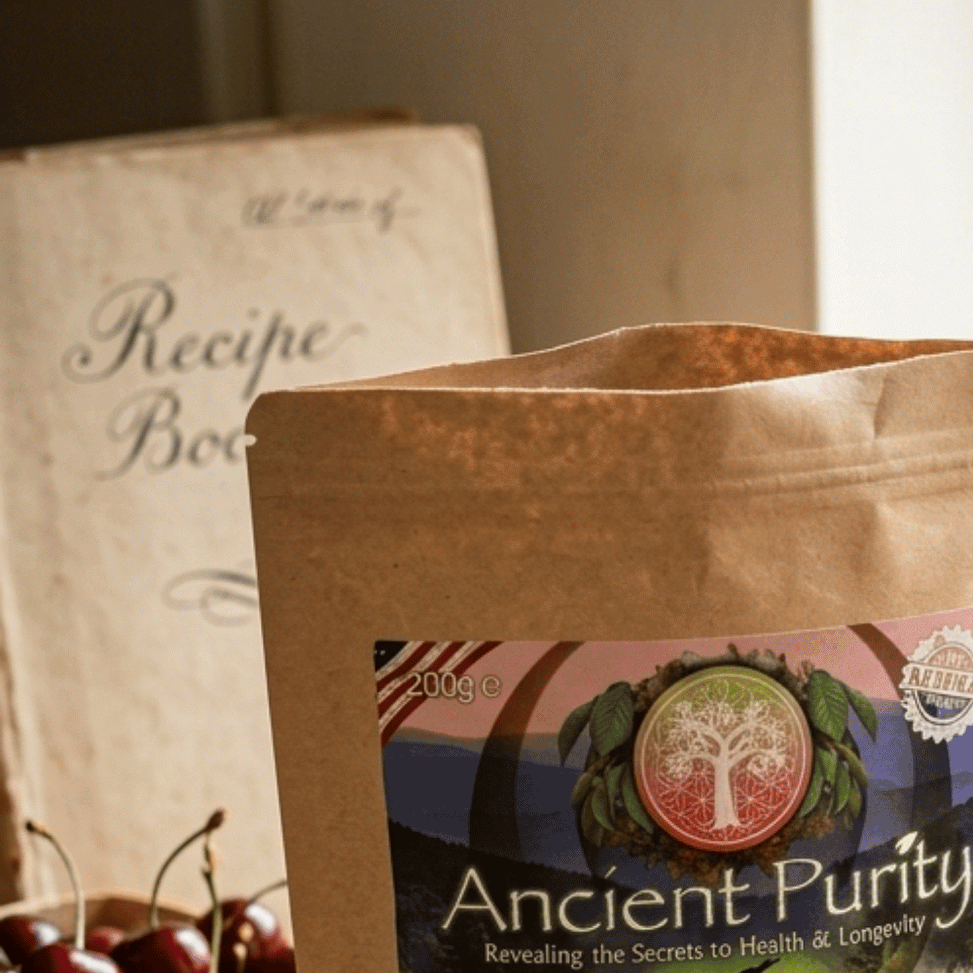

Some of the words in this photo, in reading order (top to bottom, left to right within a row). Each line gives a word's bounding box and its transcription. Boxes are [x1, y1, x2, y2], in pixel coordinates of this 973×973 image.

[61, 273, 368, 402] Recipe
[406, 672, 475, 704] 200g
[441, 865, 750, 933] Ancient
[773, 831, 971, 929] Purity
[484, 942, 584, 970] Revealing
[592, 943, 626, 965] the
[631, 942, 704, 963] Secrets
[710, 942, 732, 959] to
[739, 931, 805, 957] Health
[838, 913, 927, 947] Longevity
